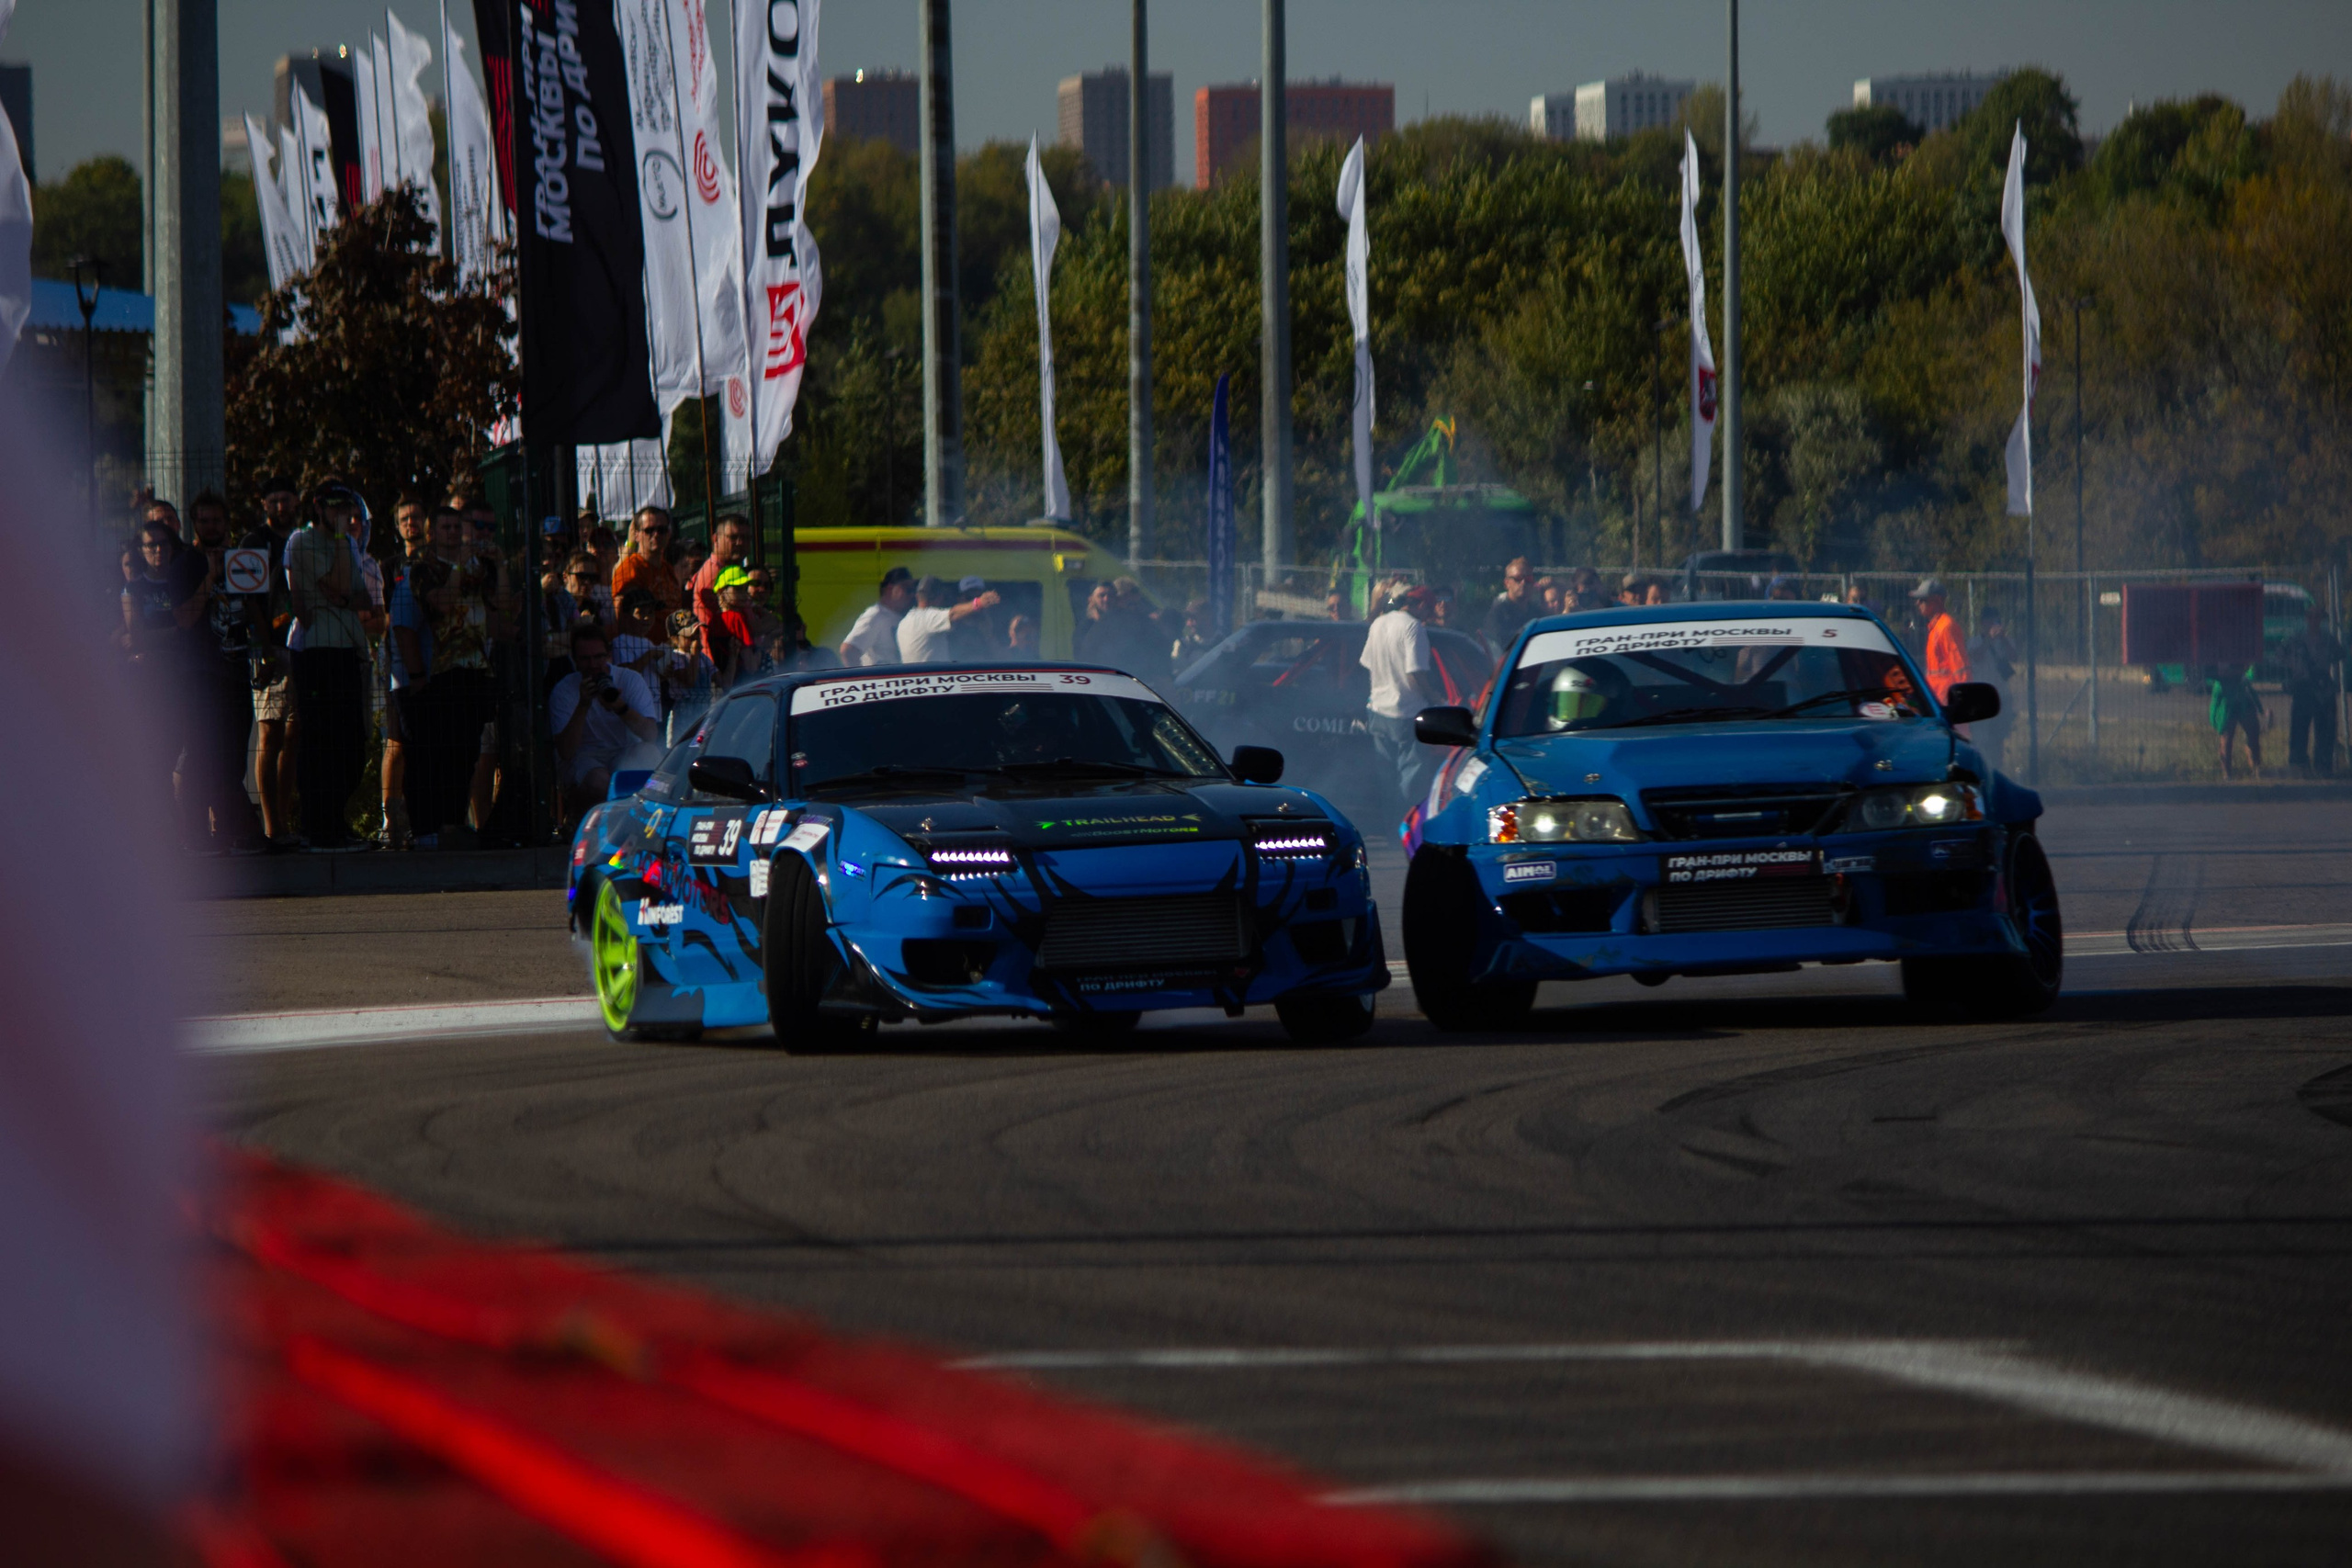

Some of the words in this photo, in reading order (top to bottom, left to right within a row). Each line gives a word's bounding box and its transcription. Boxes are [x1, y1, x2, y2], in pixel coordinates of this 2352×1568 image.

[537, 29, 574, 243] МОСКВЫ
[575, 103, 605, 173] ПО
[1576, 631, 1685, 647] ГРАН-ПРИ
[1691, 628, 1792, 637] МОСКВЫ
[1822, 628, 1838, 637] 5
[1577, 646, 1608, 656] ПО
[1612, 637, 1707, 653] ДРИФТУ
[820, 676, 932, 698] ГРАН-ПРИ
[936, 673, 1037, 685] МОСКВЫ
[1058, 674, 1091, 685] 39
[825, 694, 856, 706] ПО
[862, 684, 956, 705] ДРИФТУ
[1060, 815, 1177, 827] TRAILHEAD
[718, 818, 742, 856] 39
[1668, 853, 1743, 868] ГРАН-ПРИ
[1744, 850, 1814, 863] МОСКВЫ
[1669, 871, 1692, 882] ПО
[1693, 866, 1758, 882] ДРИФТУ
[1080, 982, 1101, 992] ПО
[1104, 978, 1166, 992] ДРИФТУ
